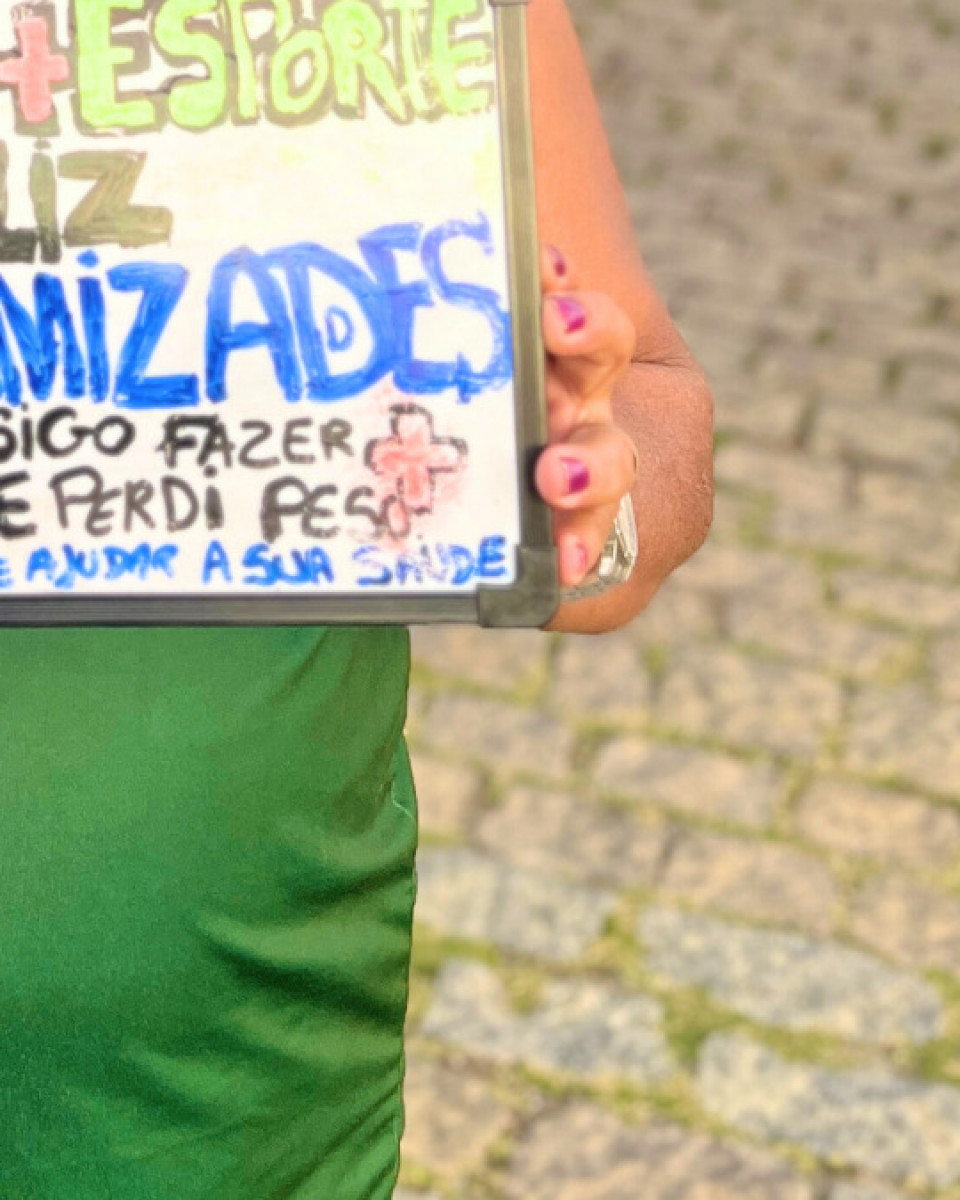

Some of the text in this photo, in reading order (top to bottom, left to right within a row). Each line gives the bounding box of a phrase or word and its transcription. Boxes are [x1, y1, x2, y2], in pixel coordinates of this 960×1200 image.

[156, 414, 355, 469] FAZER
[48, 465, 225, 537] PERDI
[201, 540, 232, 584] A
[242, 542, 335, 586] SUA
